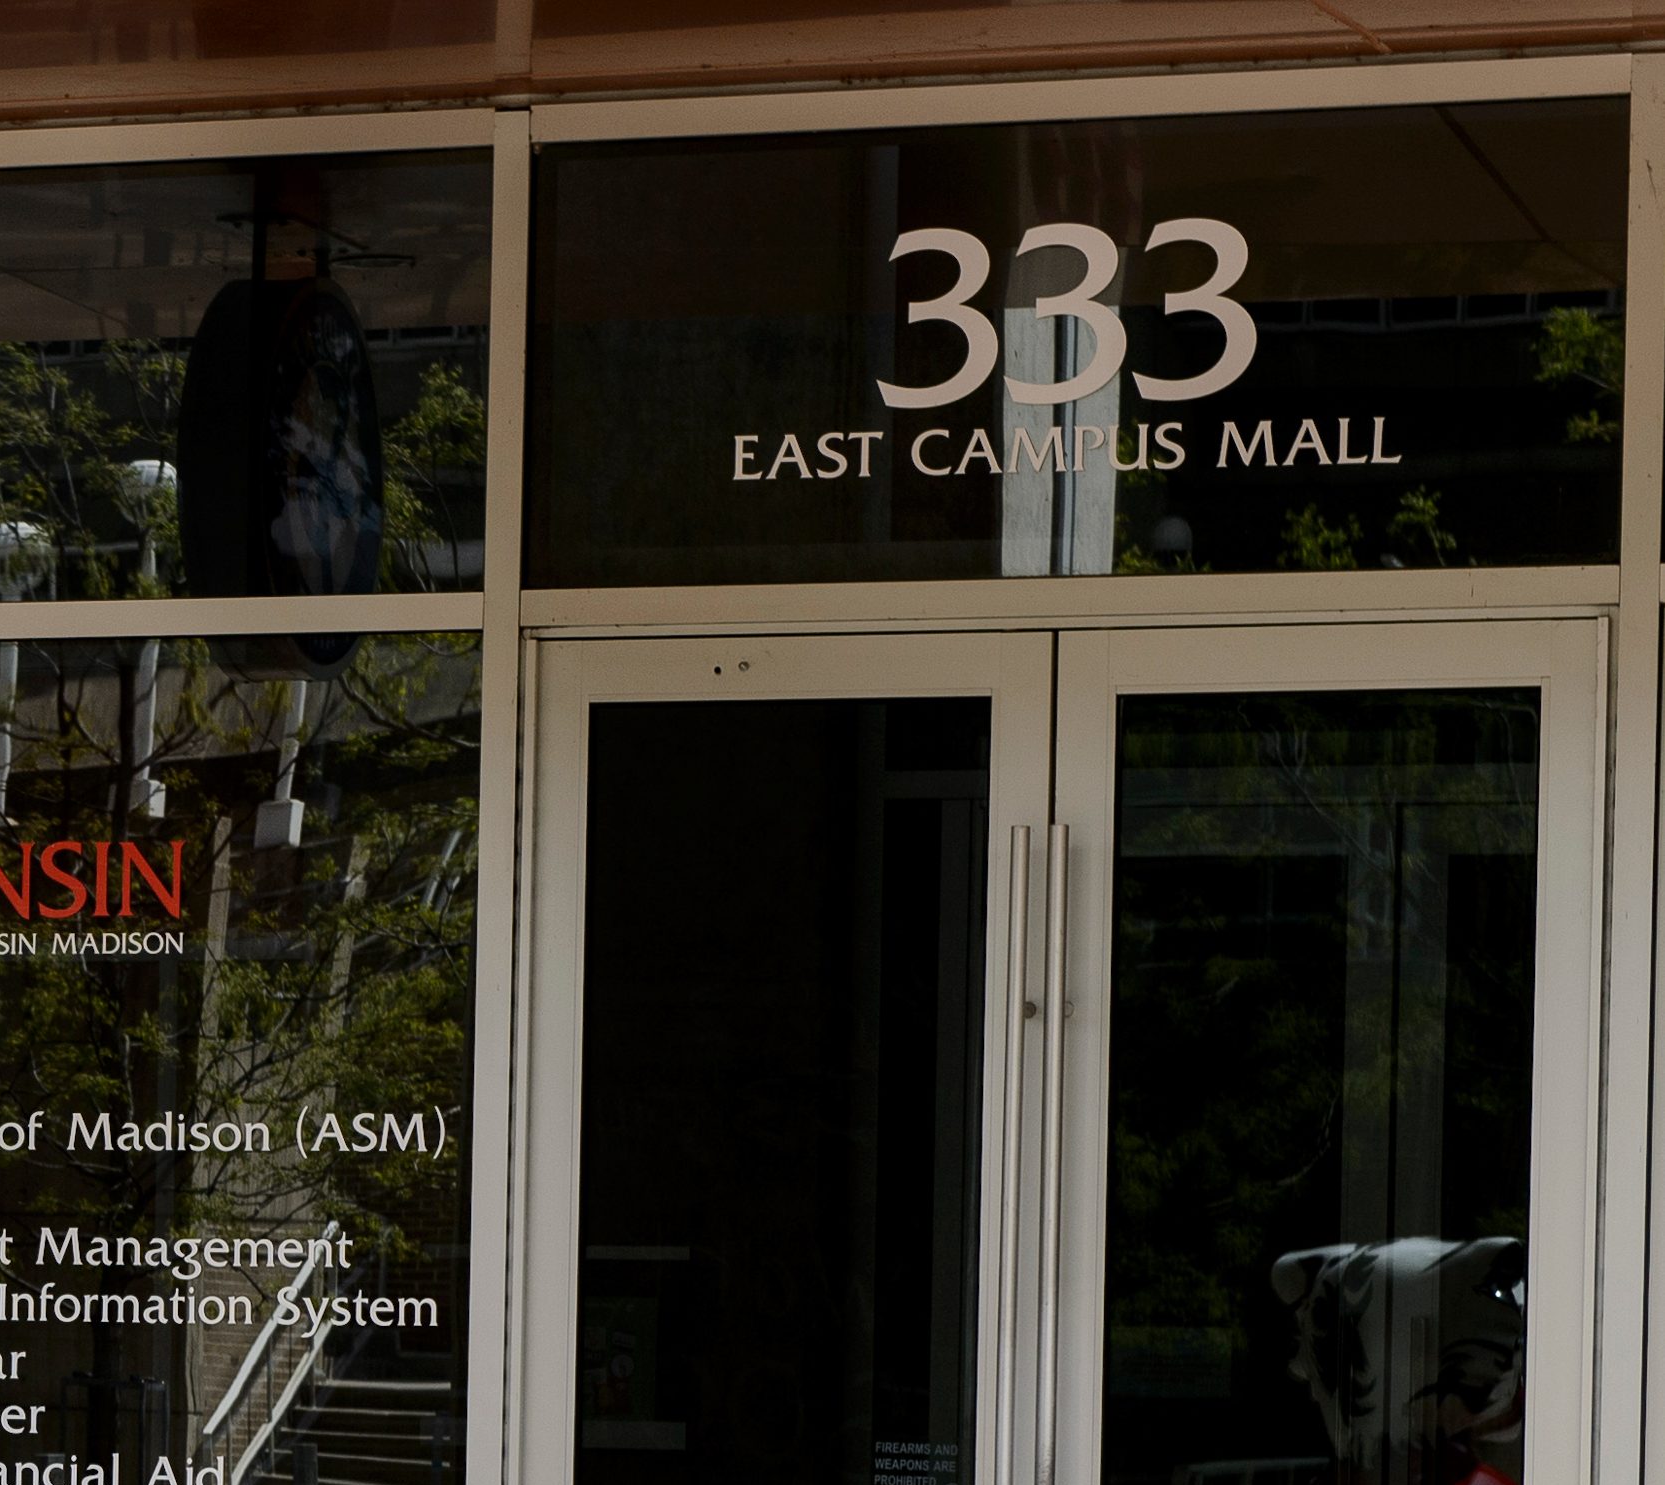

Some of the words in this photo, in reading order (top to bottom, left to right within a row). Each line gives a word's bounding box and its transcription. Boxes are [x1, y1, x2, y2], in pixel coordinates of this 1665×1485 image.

[876, 217, 1258, 409] 333
[733, 431, 883, 481] EAST
[910, 422, 1187, 477] CAMPUS
[1216, 416, 1404, 470] MALL
[51, 931, 184, 956] MADISON
[67, 1111, 271, 1153] Madison
[295, 1104, 447, 1160] (ASM)
[35, 1226, 353, 1280] Management
[276, 1286, 439, 1337] System
[874, 1458, 929, 1472] WEAPONS
[934, 1460, 957, 1473] ARE
[875, 1441, 931, 1455] FIREARMS
[934, 1444, 959, 1456] AND
